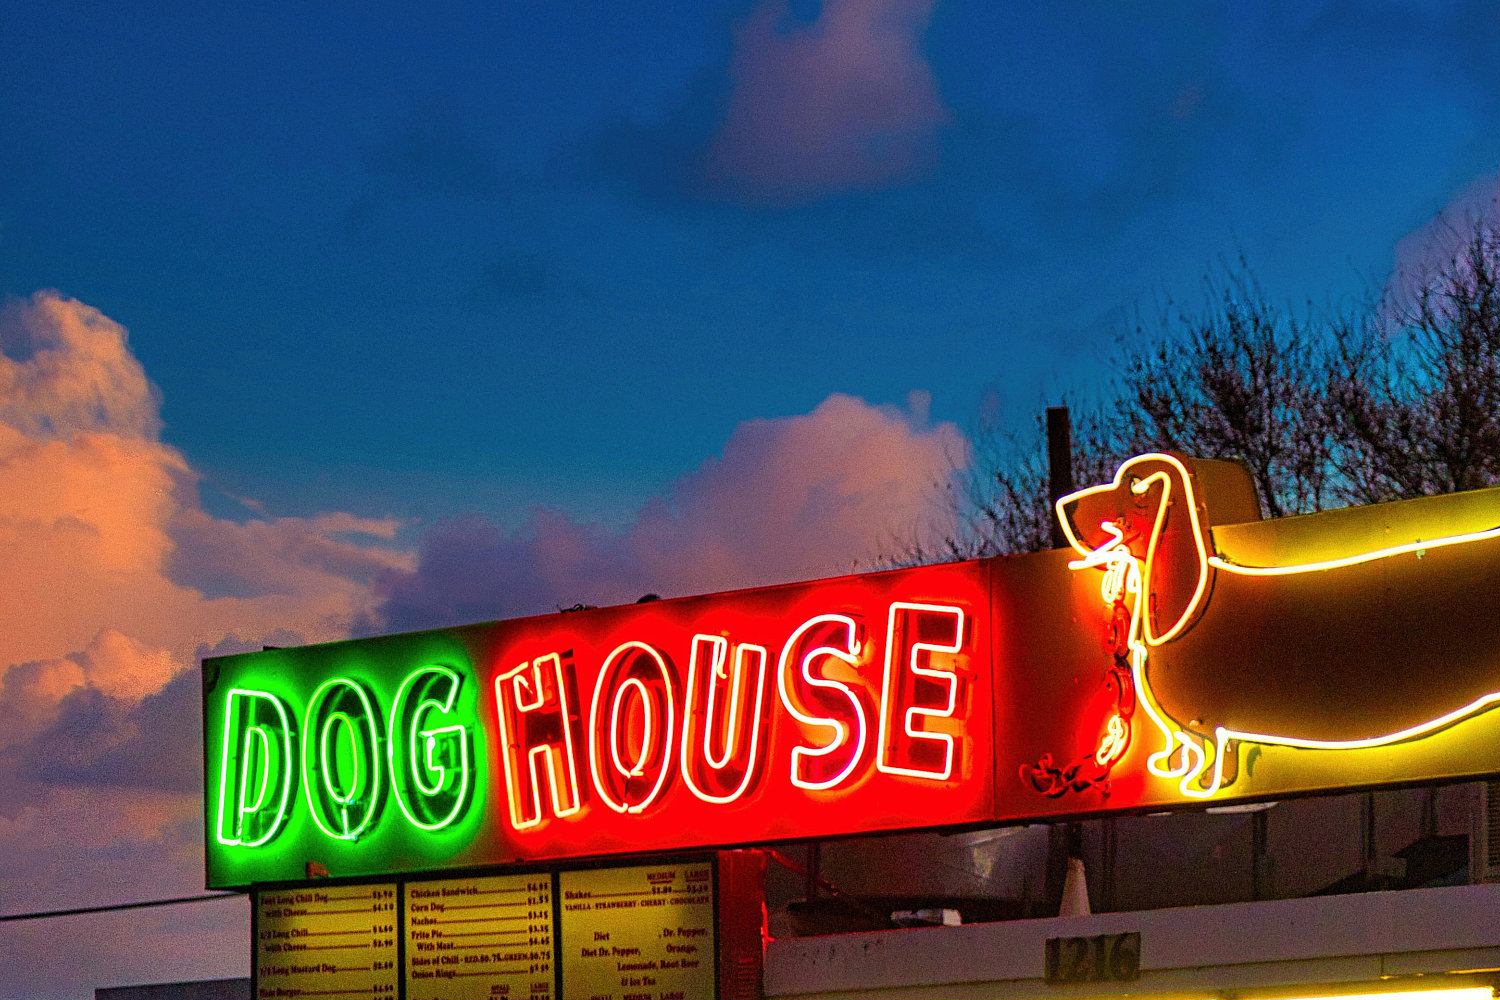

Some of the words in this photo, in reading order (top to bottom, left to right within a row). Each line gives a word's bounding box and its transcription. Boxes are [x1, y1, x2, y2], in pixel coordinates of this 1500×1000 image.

[216, 665, 468, 847] DOG
[495, 602, 965, 831] HOUSE
[647, 872, 676, 881] MEDIUM
[411, 888, 440, 899] Chicken
[442, 886, 478, 897] Sandwich
[564, 890, 591, 900] Shakes
[277, 895, 294, 905] Long
[315, 893, 328, 903] Dog
[565, 903, 591, 911] VANILLA
[595, 901, 637, 909] STRAWBERRY
[640, 898, 666, 907] CHERRY
[669, 896, 710, 905] CHOCOLATE
[283, 908, 307, 917] Cheese
[411, 903, 429, 912] Corn
[430, 902, 445, 913] Dog
[411, 917, 437, 926] Nachos
[411, 931, 430, 940] Frito
[431, 930, 443, 939] Pie
[594, 931, 610, 941] Diet
[663, 928, 676, 937] Dr.
[283, 943, 307, 952] Cheese
[417, 942, 435, 951] With
[436, 942, 454, 950] Meat
[581, 948, 597, 958] Diet
[598, 947, 611, 957] Dr.
[1045, 932, 1140, 981] 1216
[411, 957, 431, 966] Sides
[432, 956, 440, 965] of
[660, 959, 679, 969] Root
[681, 958, 700, 968] Beer
[291, 964, 320, 973] Mustard
[321, 963, 336, 973] Dog
[411, 971, 434, 979] Onion
[435, 969, 456, 979] Rings
[629, 978, 641, 987] Ice
[642, 977, 656, 987] Tea
[660, 992, 684, 1000] LARGE
